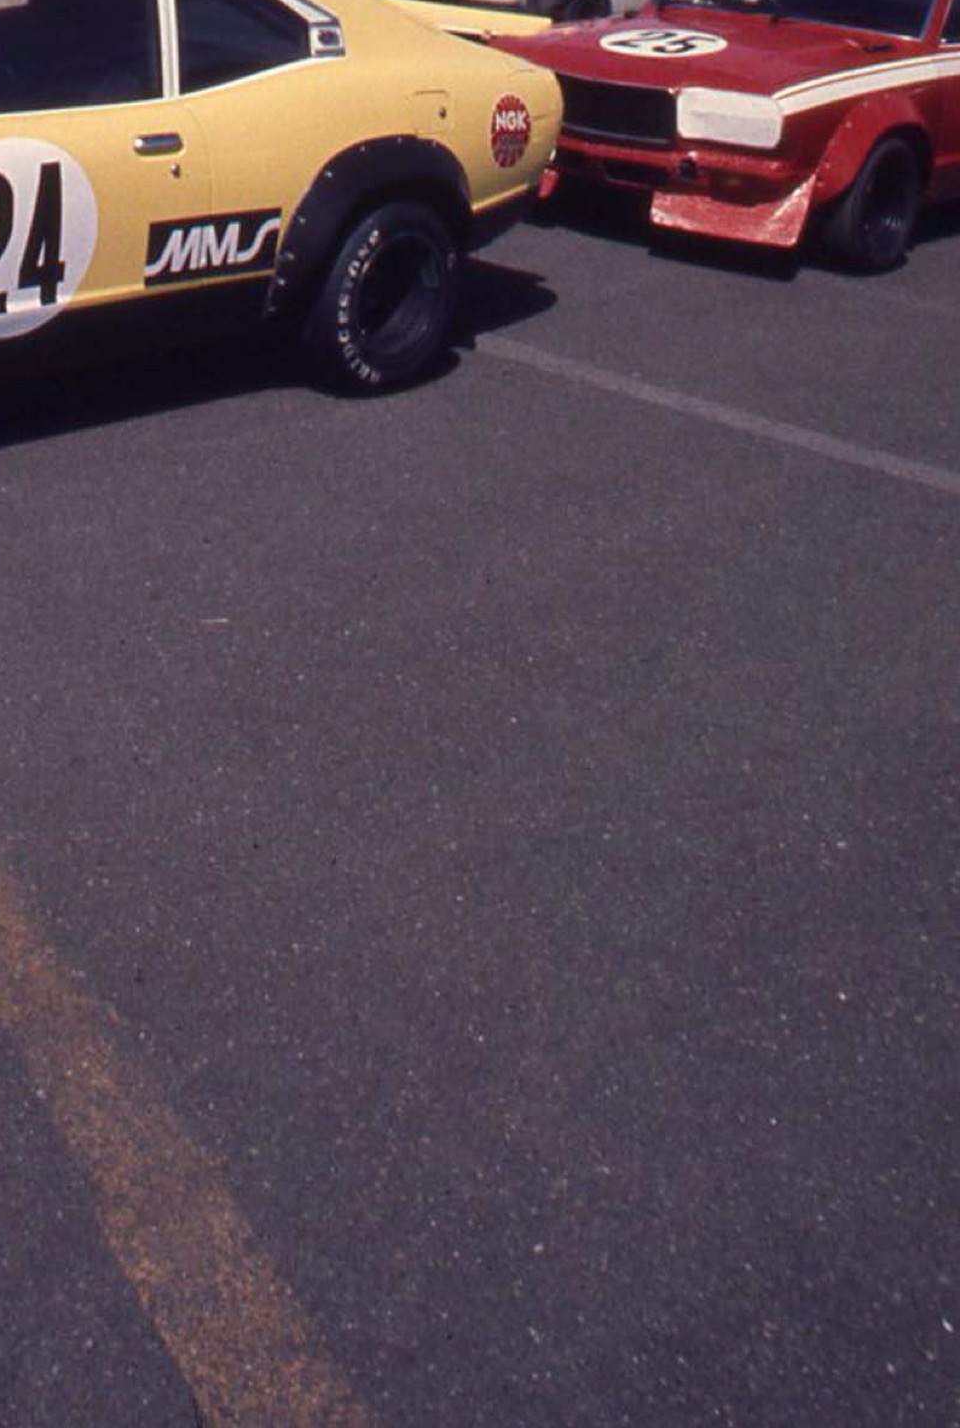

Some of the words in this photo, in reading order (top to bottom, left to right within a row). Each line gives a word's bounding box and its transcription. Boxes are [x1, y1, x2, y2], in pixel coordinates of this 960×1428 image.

[607, 32, 716, 53] 25
[495, 110, 528, 130] NGK
[143, 217, 282, 278] MMS
